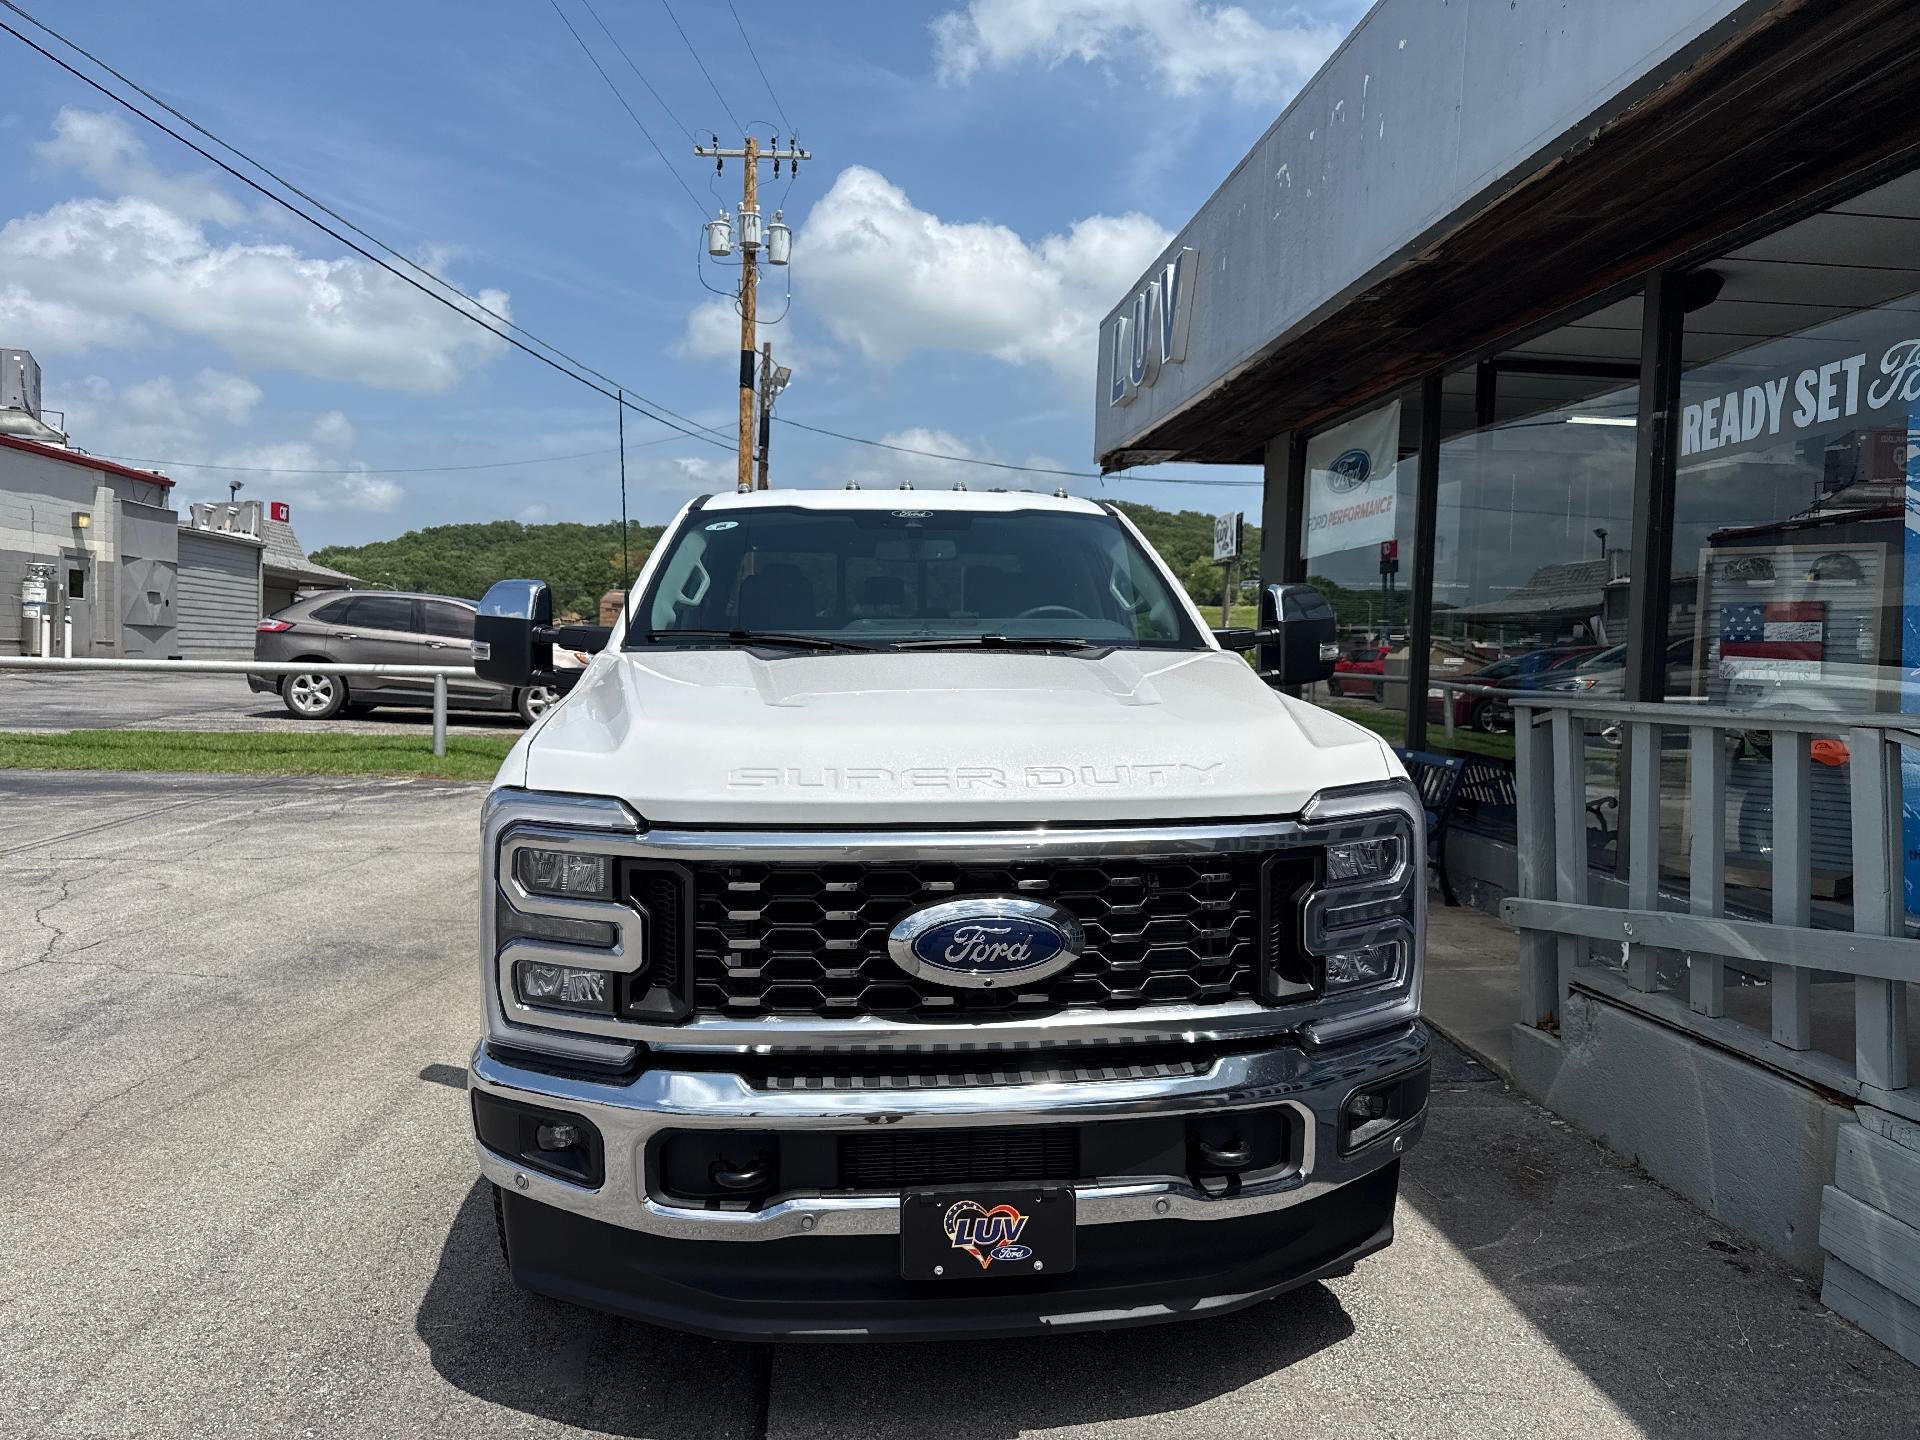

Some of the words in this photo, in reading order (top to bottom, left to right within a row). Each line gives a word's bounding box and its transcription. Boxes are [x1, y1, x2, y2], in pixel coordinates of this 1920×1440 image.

[1110, 246, 1199, 407] LUV
[1681, 376, 1788, 457] READY
[1793, 353, 1866, 428] SET
[1328, 495, 1393, 526] PERFORMANCE
[728, 767, 1006, 790] SUPER
[1024, 762, 1224, 789] DUTY
[944, 925, 1034, 963] Ford
[951, 1215, 1030, 1249] LUV
[998, 1247, 1024, 1259] Ford
